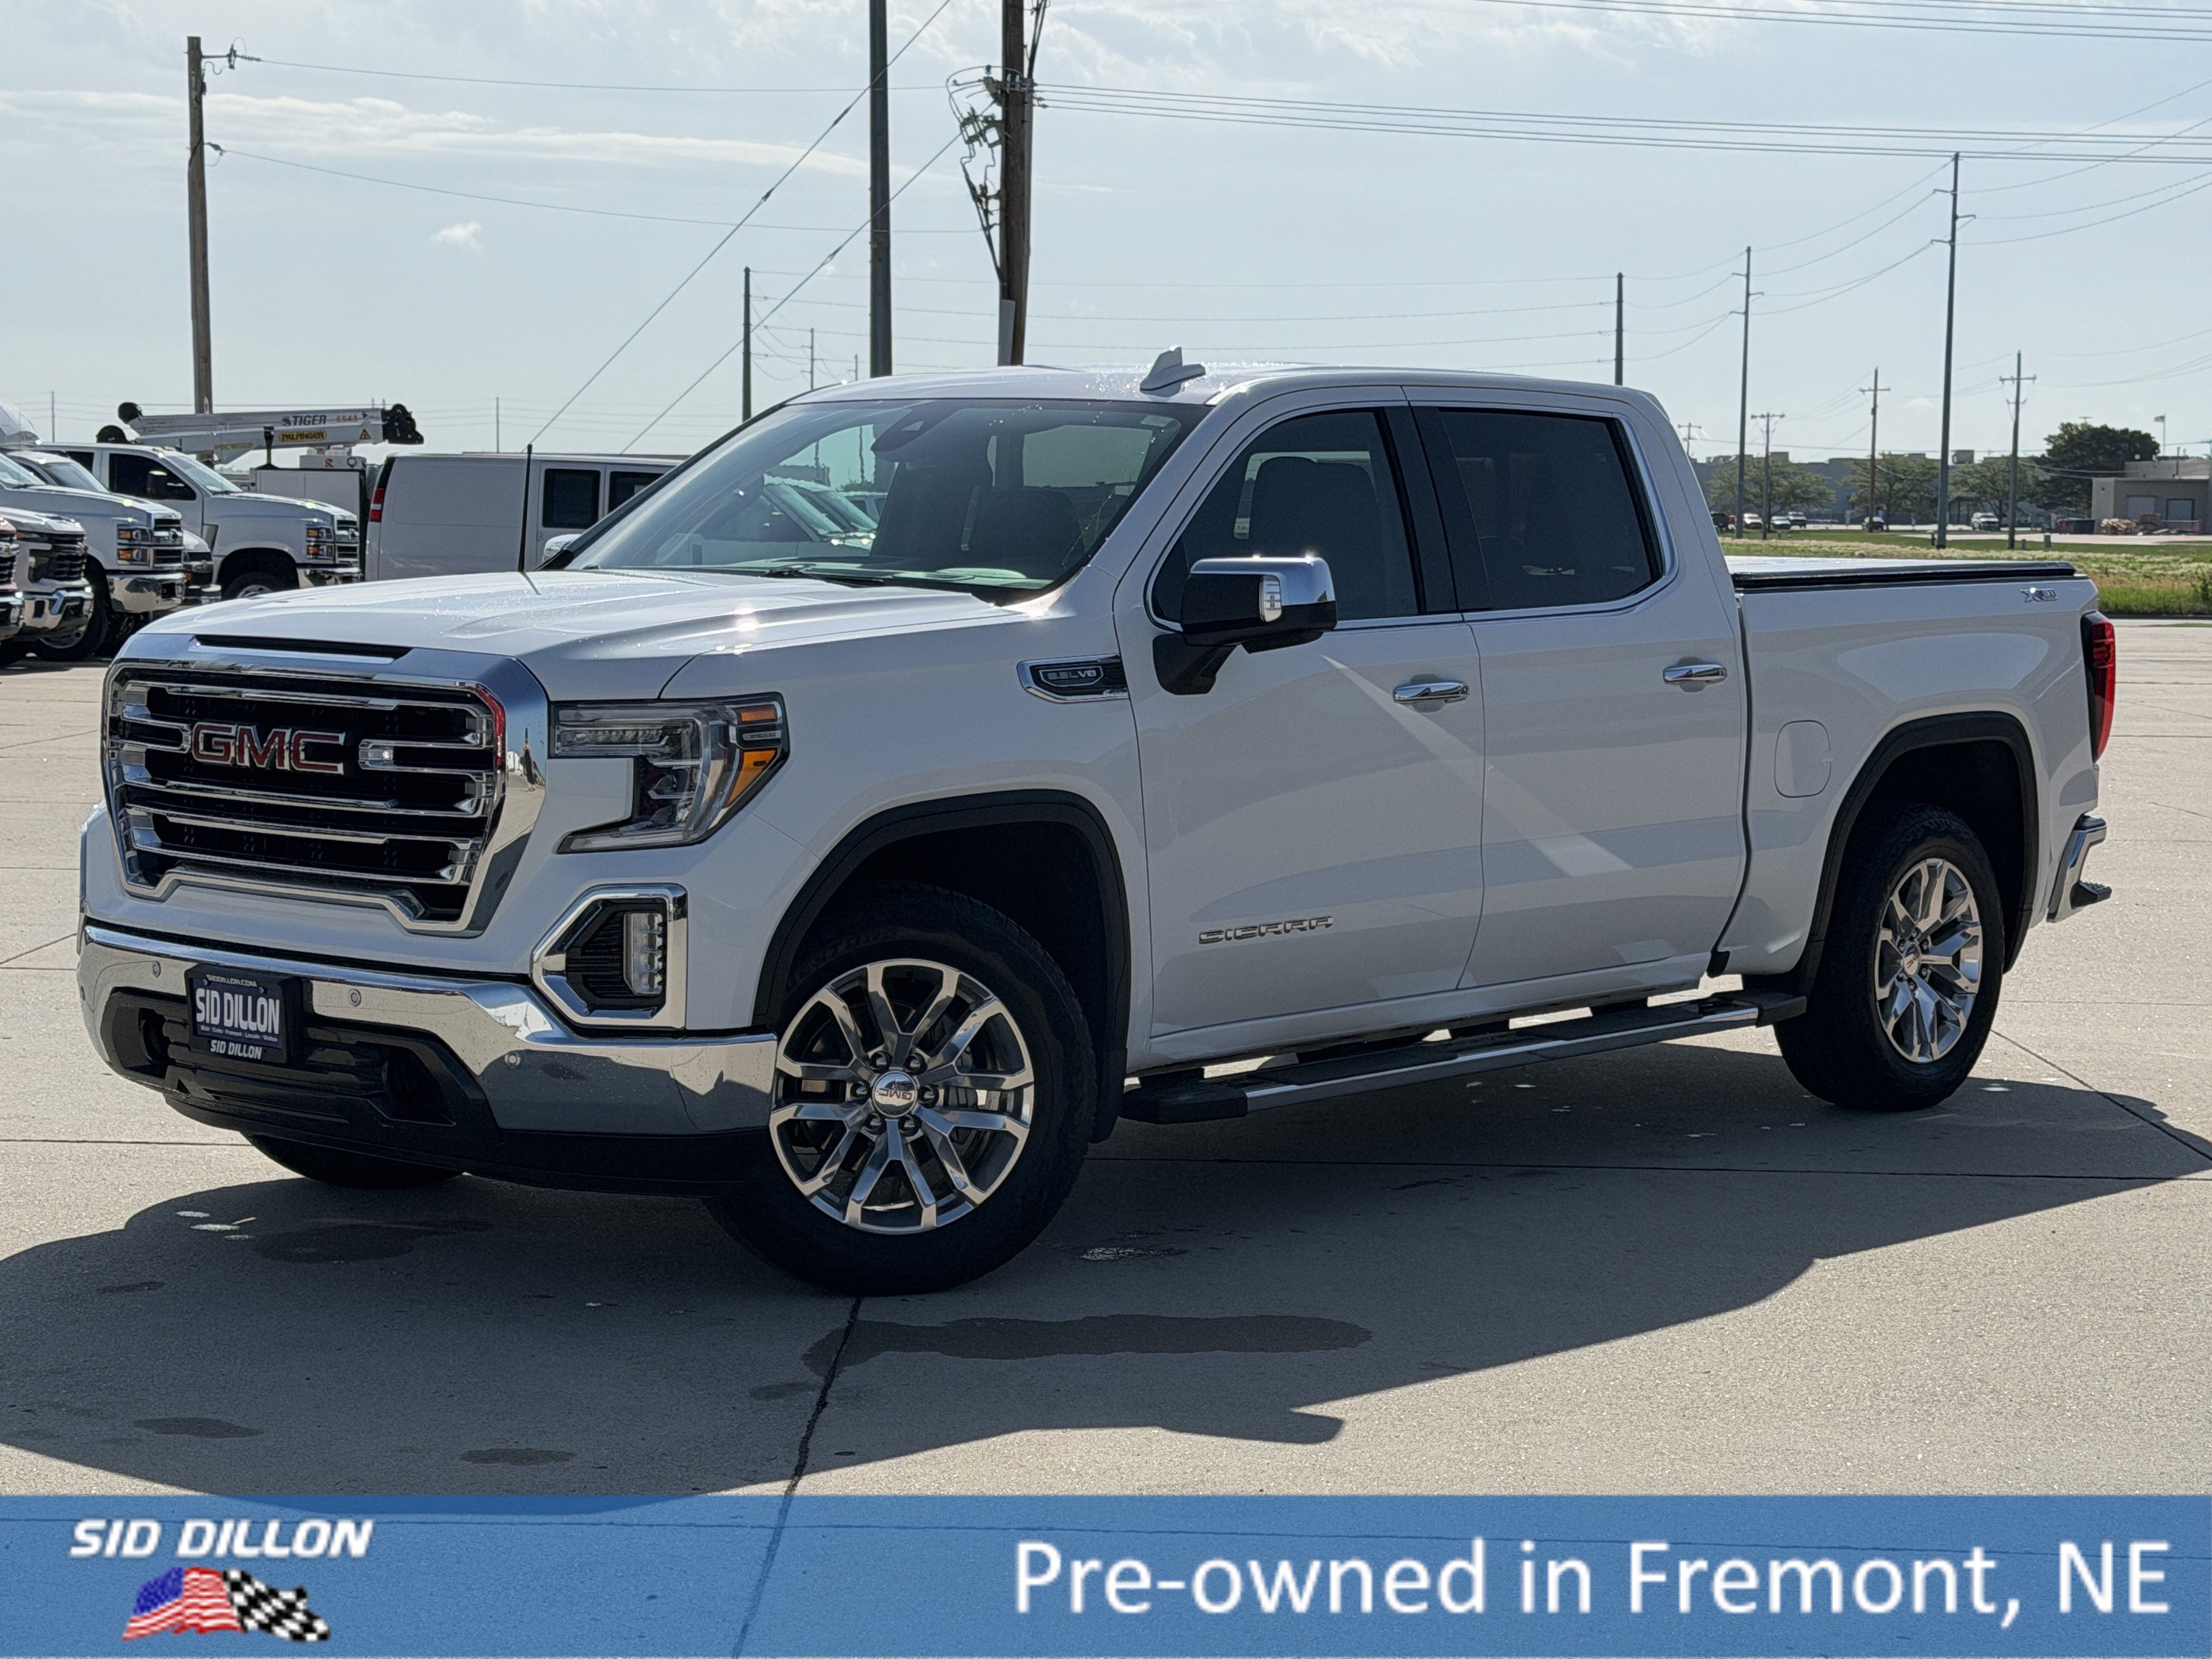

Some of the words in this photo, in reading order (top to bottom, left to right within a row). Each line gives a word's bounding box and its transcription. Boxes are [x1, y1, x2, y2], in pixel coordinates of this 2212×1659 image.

[292, 414, 328, 426] TIGER
[281, 432, 325, 442] PALFINGER
[191, 721, 346, 776] GMC
[1199, 916, 1334, 944] SIERRA
[195, 988, 220, 1025] SID
[223, 992, 280, 1035] DILLON
[210, 1040, 227, 1054] SID
[228, 1042, 263, 1060] DILLON
[878, 1087, 912, 1101] GMC
